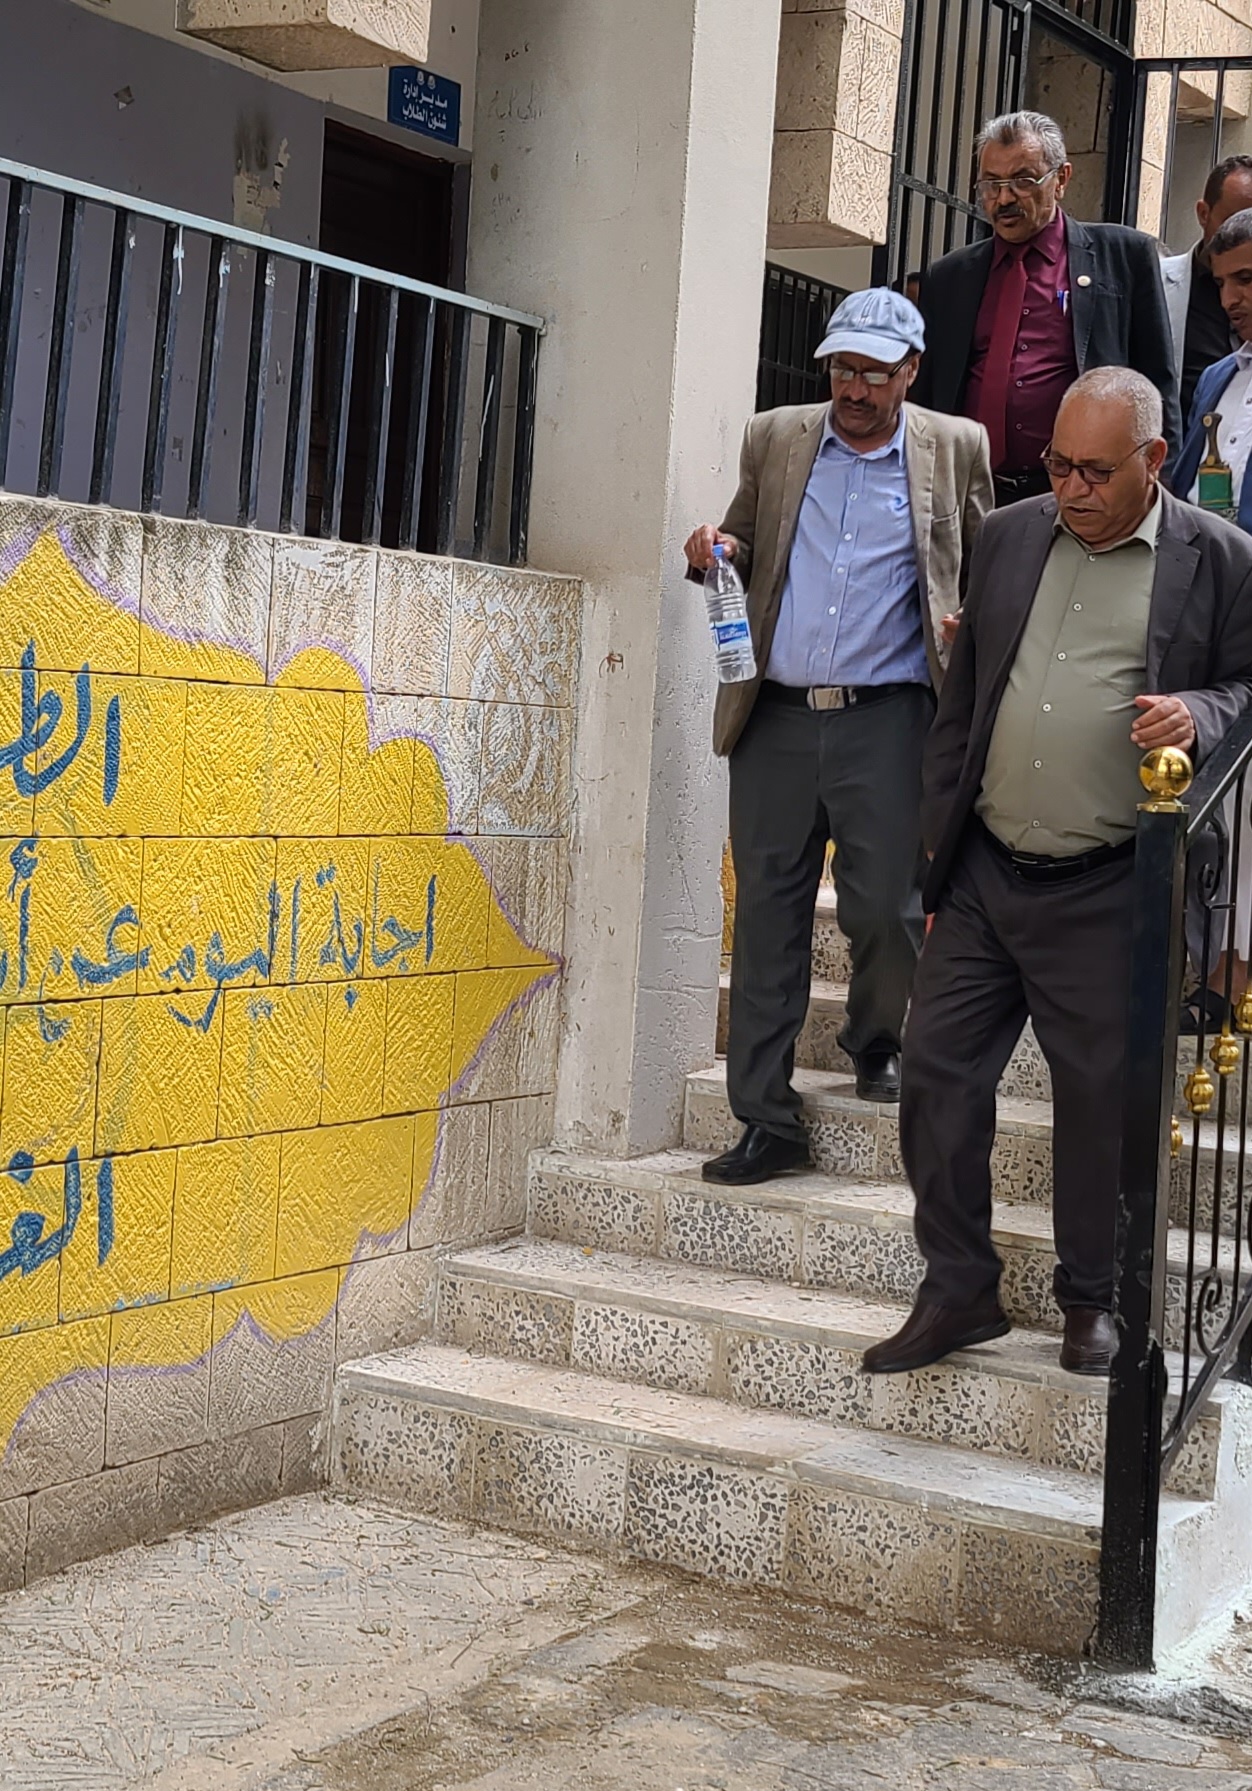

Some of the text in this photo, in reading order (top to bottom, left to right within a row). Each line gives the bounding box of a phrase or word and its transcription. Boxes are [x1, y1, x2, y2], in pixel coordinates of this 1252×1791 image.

[402, 78, 448, 109] مدير إدارة
[402, 103, 428, 122] الطلاب
[0, 637, 121, 807] الط
